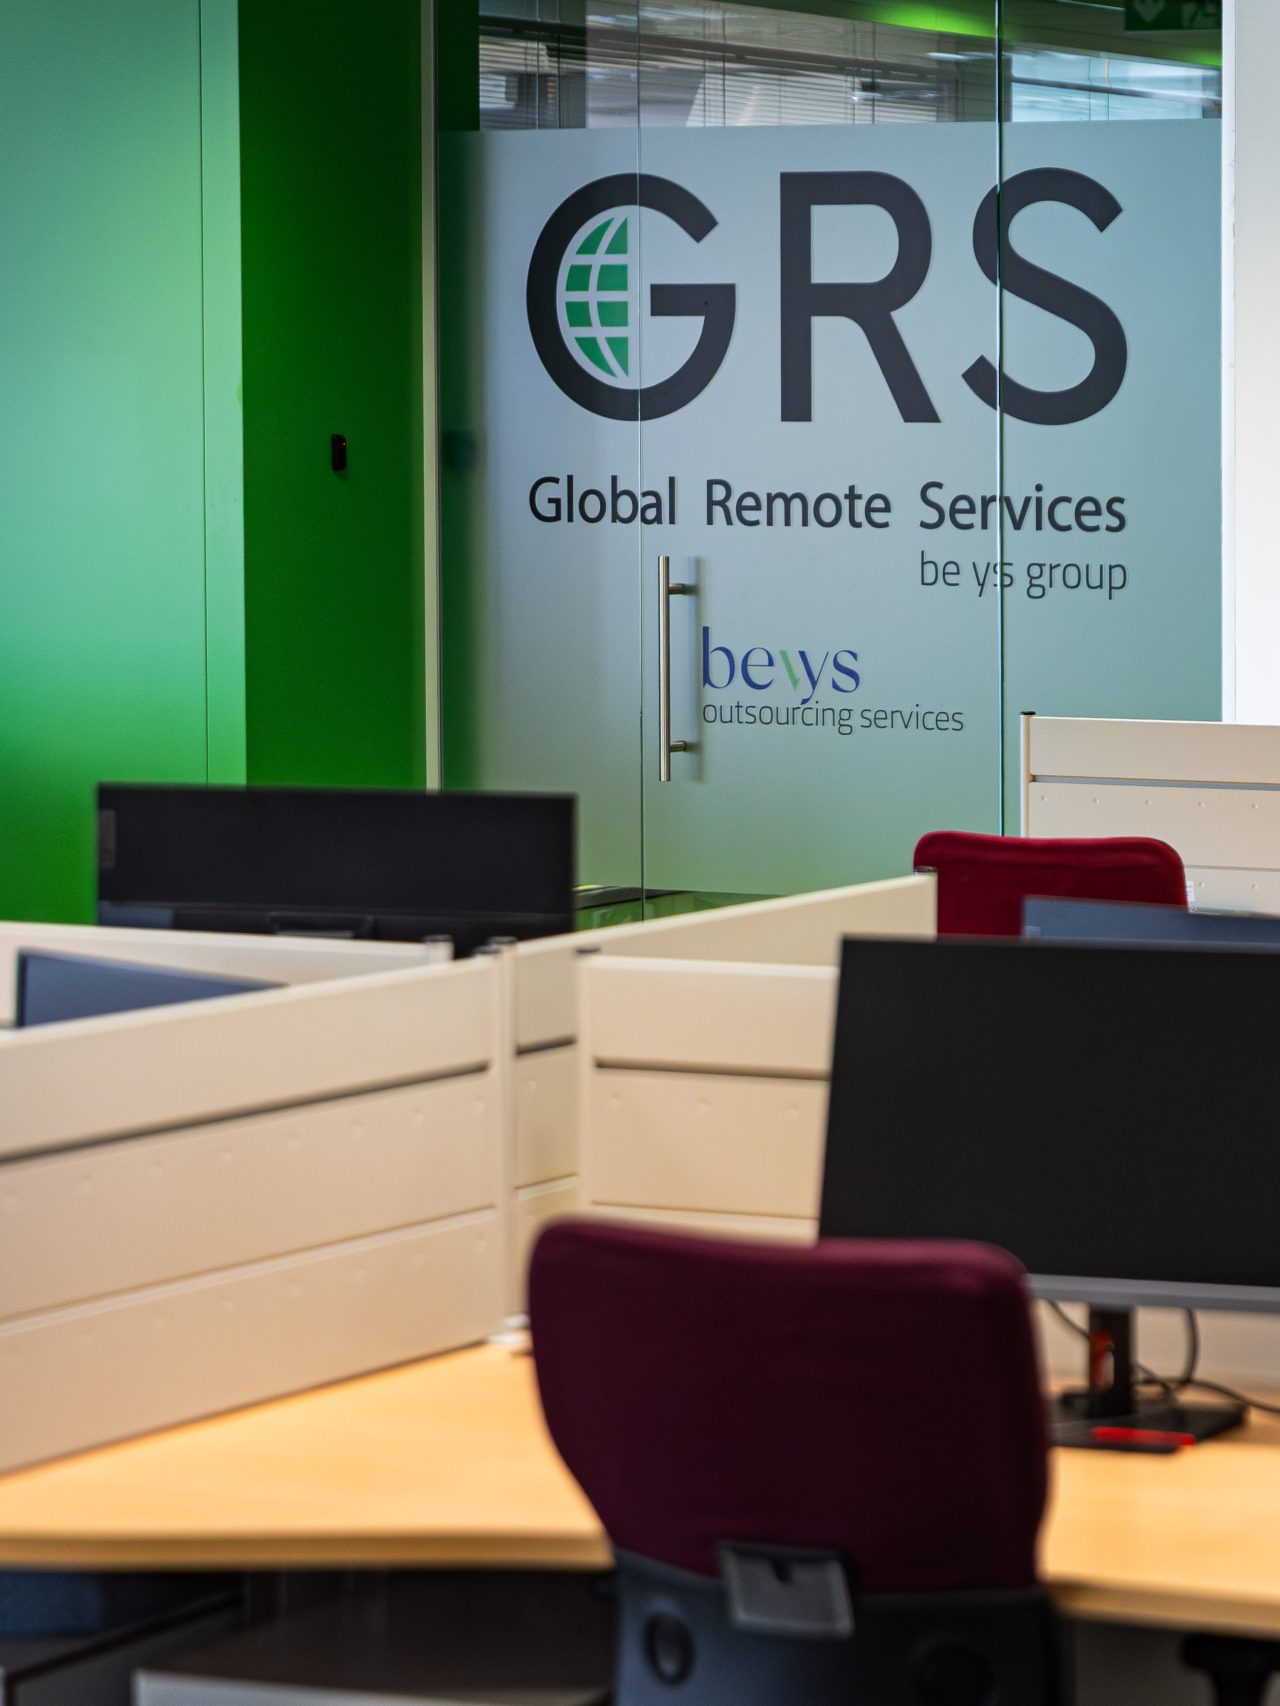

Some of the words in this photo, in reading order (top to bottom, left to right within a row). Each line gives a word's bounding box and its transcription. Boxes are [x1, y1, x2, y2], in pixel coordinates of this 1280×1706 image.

[526, 167, 1128, 427] GRS
[529, 474, 676, 526] Global
[705, 478, 892, 530] Remote
[919, 480, 1128, 534] Services
[920, 550, 961, 588] be
[971, 561, 1014, 598] ys
[1026, 562, 1128, 601] group
[702, 701, 854, 736] outsourcing
[860, 703, 965, 732] services
